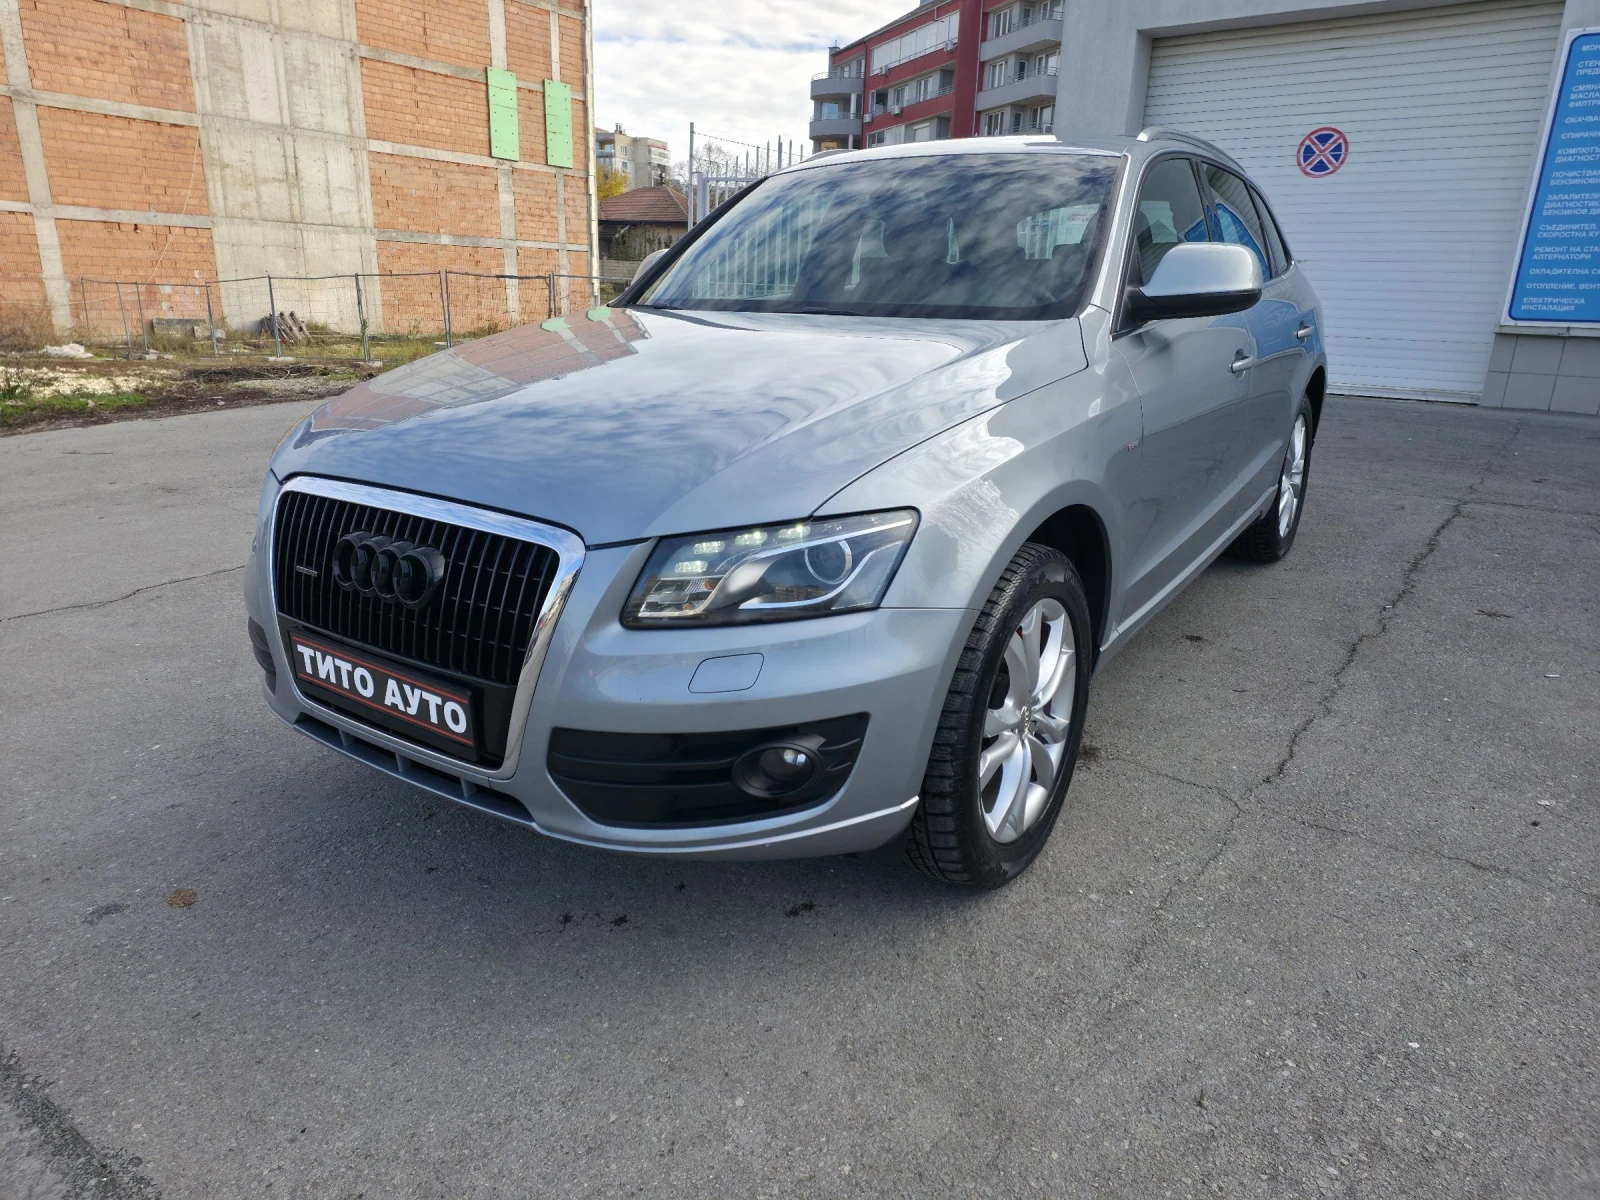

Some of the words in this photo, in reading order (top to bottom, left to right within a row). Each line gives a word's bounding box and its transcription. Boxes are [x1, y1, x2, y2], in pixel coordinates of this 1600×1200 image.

[1576, 68, 1600, 76] ПРЕД
[1565, 115, 1600, 124] ОКАЧВА
[1544, 200, 1600, 209] ДИАГНОСТИК
[1542, 208, 1588, 216] БЕНЗИНОВ
[1583, 245, 1600, 253] СТА
[1521, 304, 1575, 312] ИНСТАЛАЦИЯ
[297, 644, 374, 698] ТИТО
[384, 678, 467, 734] АУТО
